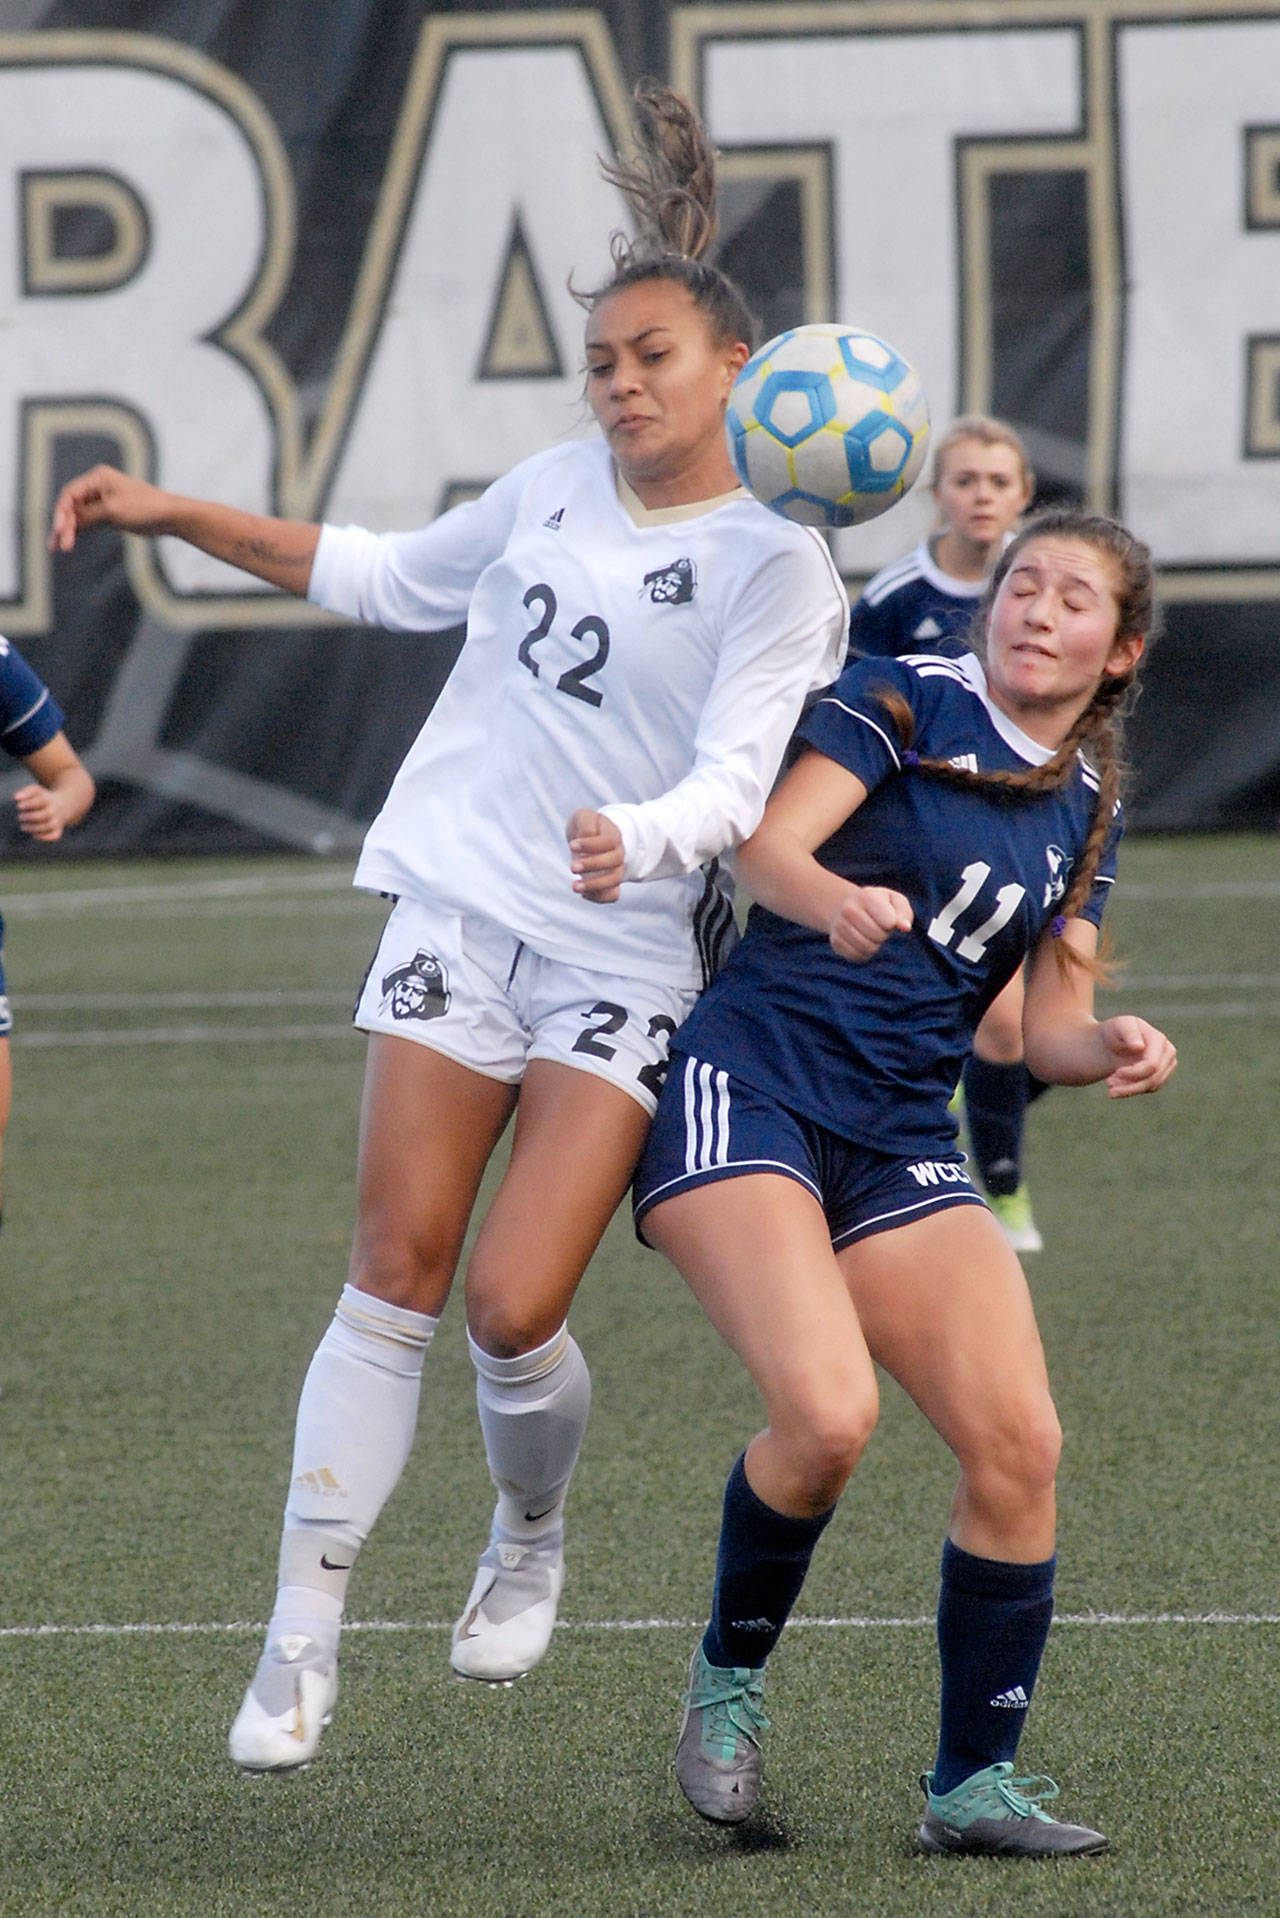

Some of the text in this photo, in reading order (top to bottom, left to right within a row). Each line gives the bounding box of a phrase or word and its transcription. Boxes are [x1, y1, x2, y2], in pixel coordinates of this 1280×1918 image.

[518, 583, 610, 708] 22
[927, 861, 1026, 963] 11
[571, 1000, 679, 1099] 22
